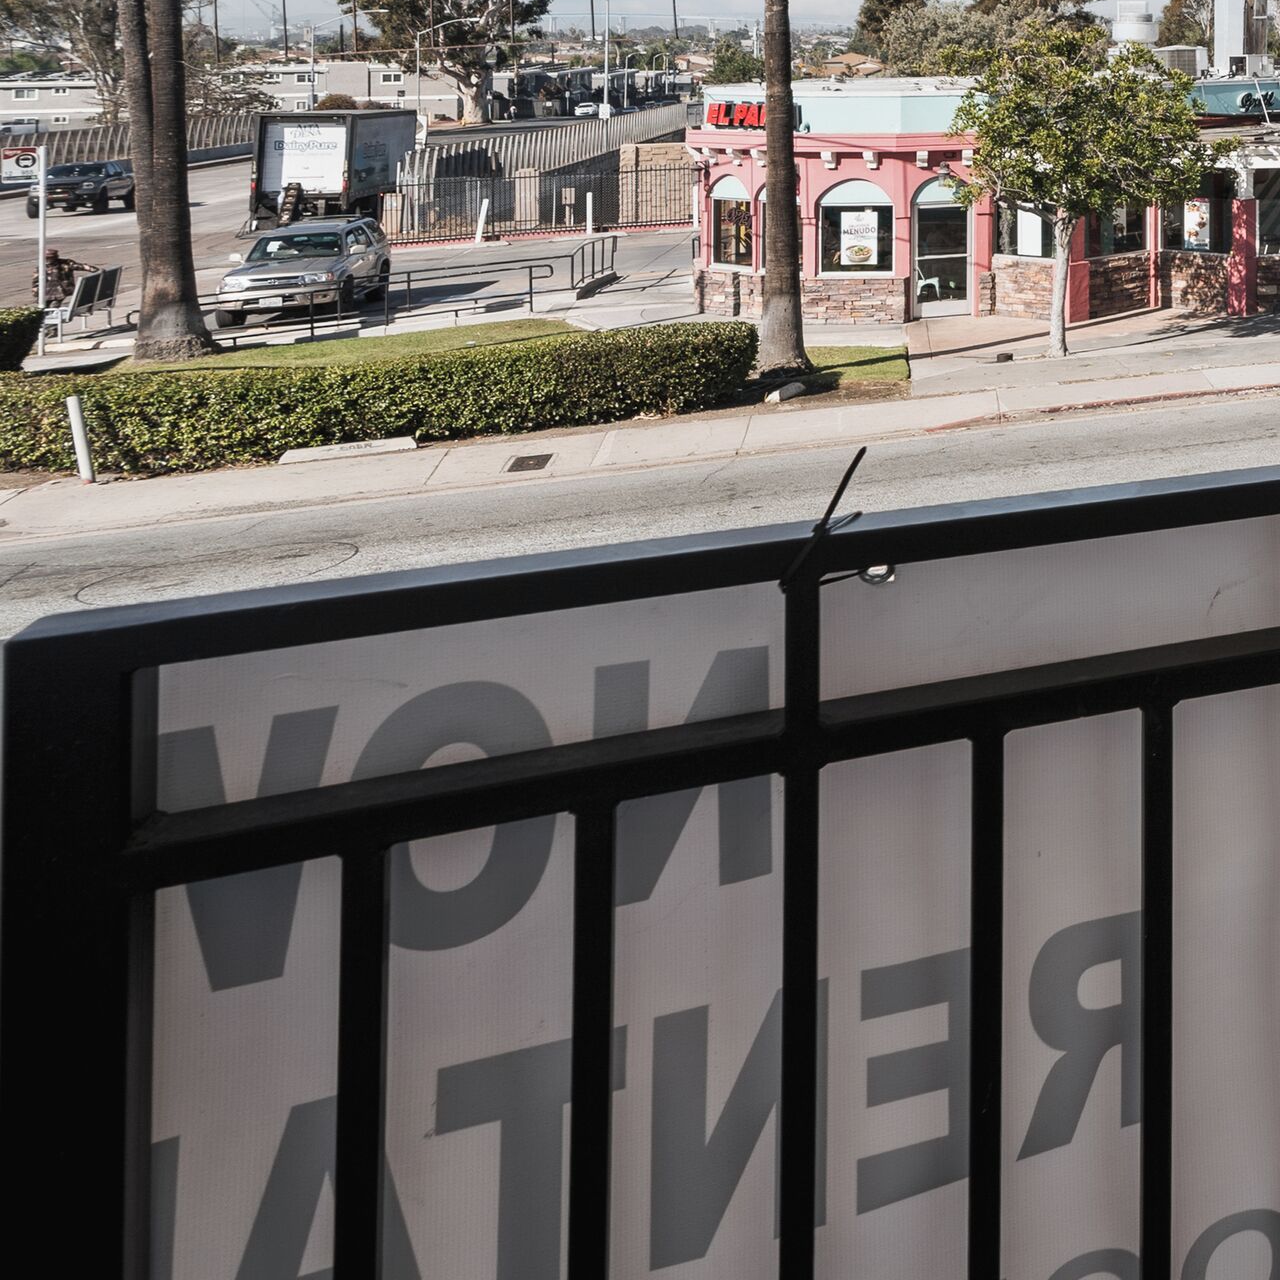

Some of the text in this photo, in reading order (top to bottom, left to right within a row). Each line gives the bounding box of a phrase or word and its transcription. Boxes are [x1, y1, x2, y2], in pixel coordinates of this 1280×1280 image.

[706, 103, 767, 126] EL PAI
[274, 140, 337, 152] DairyPure
[842, 226, 876, 235] MENUDO
